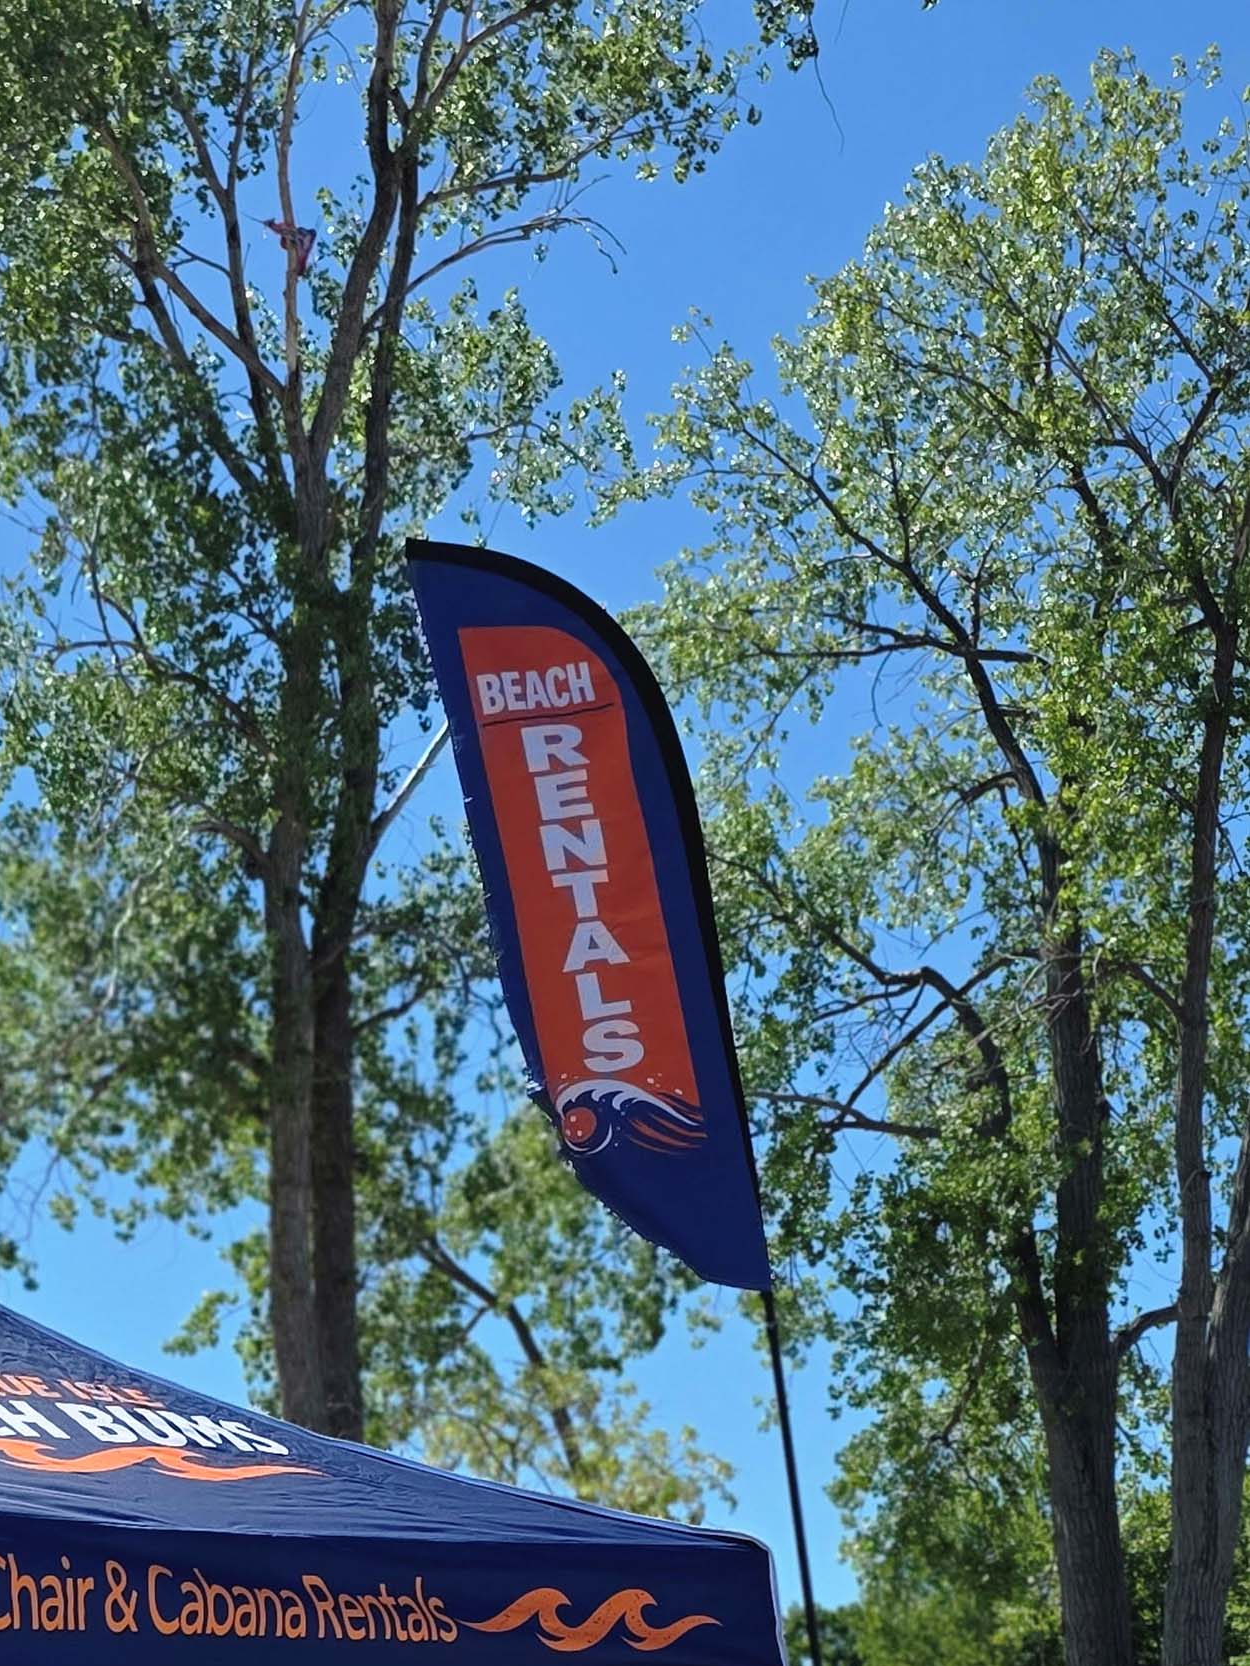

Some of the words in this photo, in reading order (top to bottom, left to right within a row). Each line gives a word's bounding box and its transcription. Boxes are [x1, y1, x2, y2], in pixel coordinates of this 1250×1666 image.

[476, 662, 594, 716] BEACH
[520, 724, 644, 1074] RENTALS
[57, 1378, 166, 1408] ISLE
[56, 1402, 290, 1456] BUMS
[102, 1560, 139, 1634] &
[149, 1566, 306, 1638] Cabana
[301, 1575, 459, 1643] Rentals
